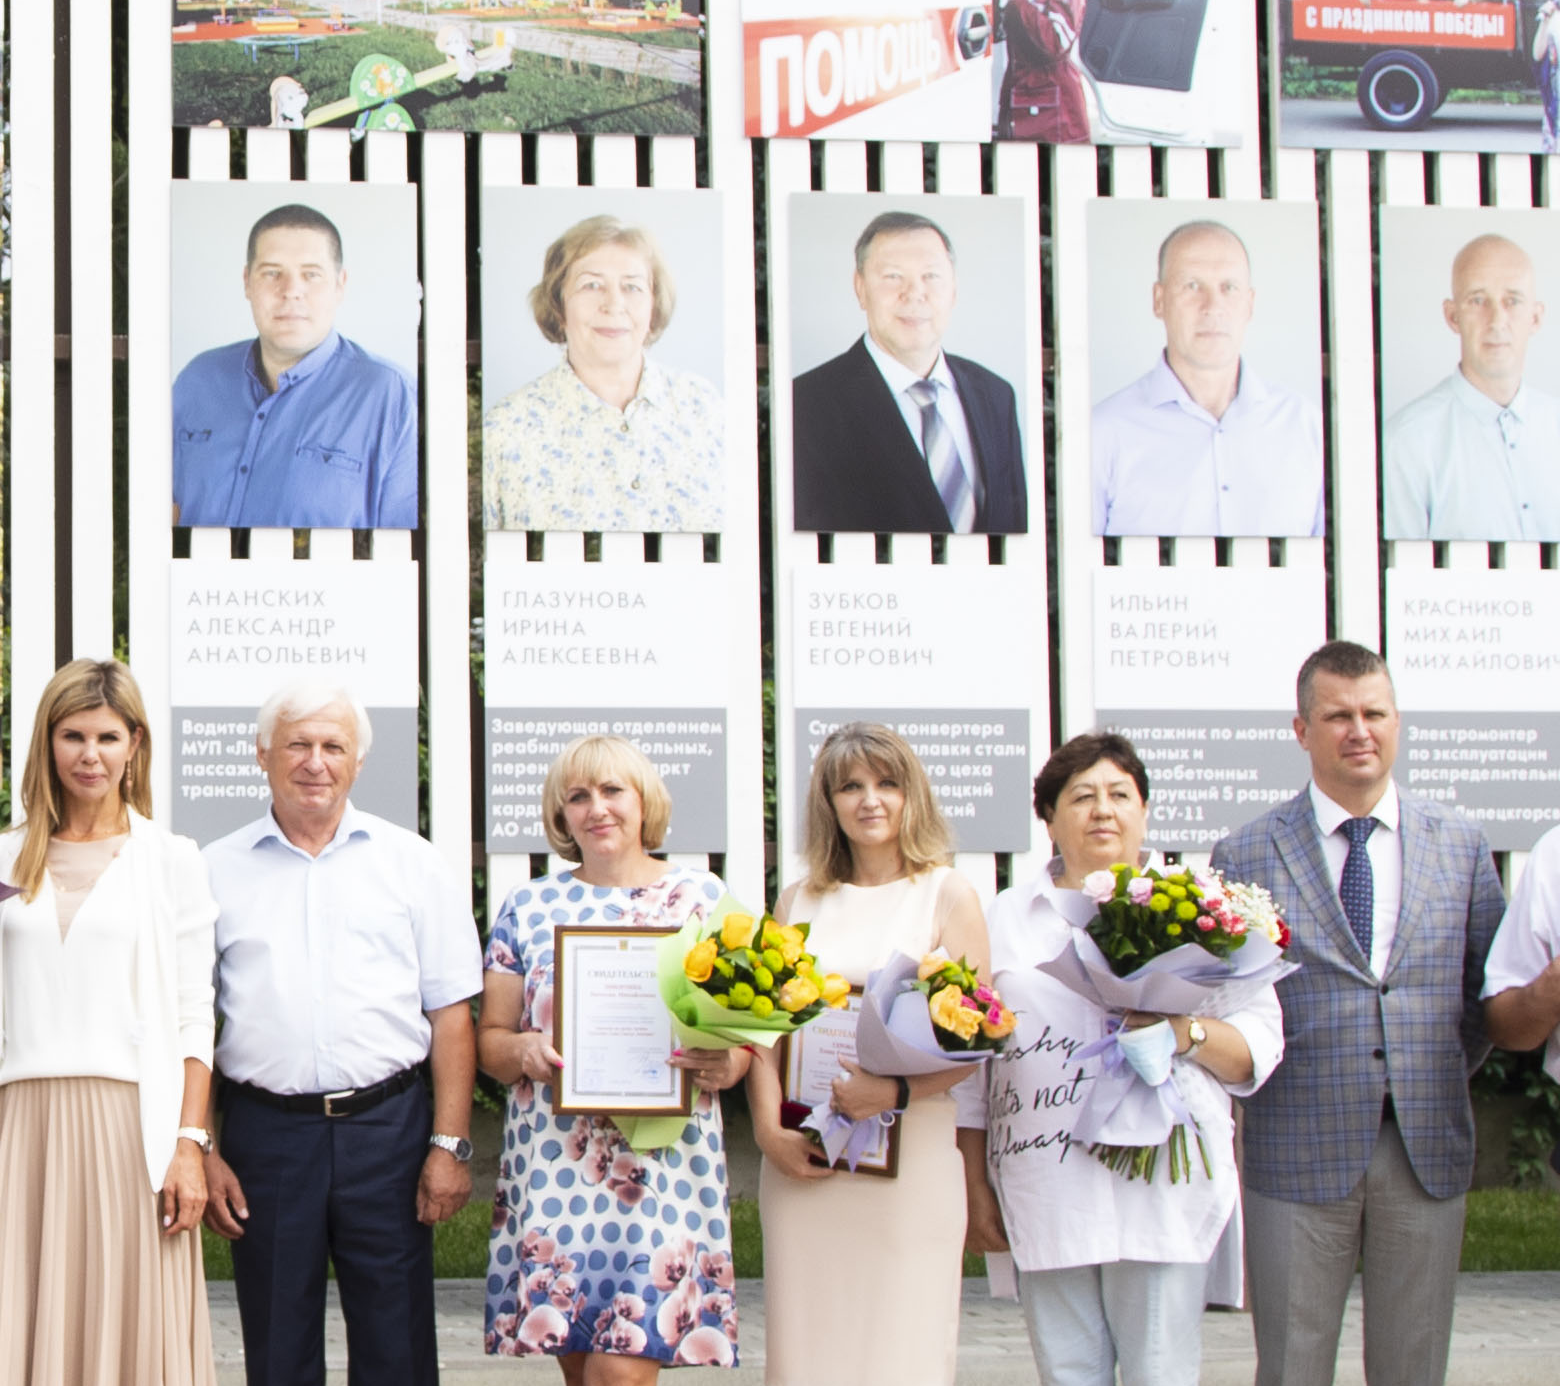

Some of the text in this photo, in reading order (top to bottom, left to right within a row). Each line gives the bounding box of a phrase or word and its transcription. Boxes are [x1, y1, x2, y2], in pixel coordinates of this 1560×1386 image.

[1306, 6, 1504, 38] С ПРАЗДНИКОМ ПОБЕДЫ!
[759, 19, 941, 136] ПОМОЩЬ
[188, 591, 326, 606] АНАНСКИХ
[503, 592, 646, 608] ГЛАЗУНОВА
[809, 594, 897, 610] ЗУБКОВ
[1110, 595, 1187, 611] ИЛЬИН
[1404, 600, 1533, 616] КРАСНИКОВ
[188, 618, 336, 637] АЛЕКСАНДР
[503, 620, 586, 636] ИРИНА
[809, 617, 911, 637] ЕВГЕНИЙ
[1110, 620, 1217, 639] ВАЛЕРИЙ
[1404, 627, 1501, 643] МИХАИЛ
[188, 647, 366, 663] АНАТОЛЬЕВИЧ
[502, 648, 656, 664] АЛЕКСЕЕВНА
[809, 649, 932, 665] ЕГОРОВИЧ
[1110, 651, 1230, 667] ПЕТРОВИЧ
[182, 720, 258, 736] Водител
[492, 719, 722, 737] Заведующая отделением
[899, 723, 1004, 739] конвертера
[1211, 728, 1230, 740] по
[1408, 726, 1537, 743] Электромонтер
[182, 741, 222, 755] МУП
[974, 743, 1025, 756] стали
[1194, 748, 1203, 759] и
[1409, 749, 1547, 764] по эксплуатации
[950, 764, 992, 779] цеха
[1222, 788, 1232, 801] 5
[1154, 807, 1203, 820] СУ-11
[492, 824, 518, 837] АО
[1034, 1067, 1096, 1110] not
